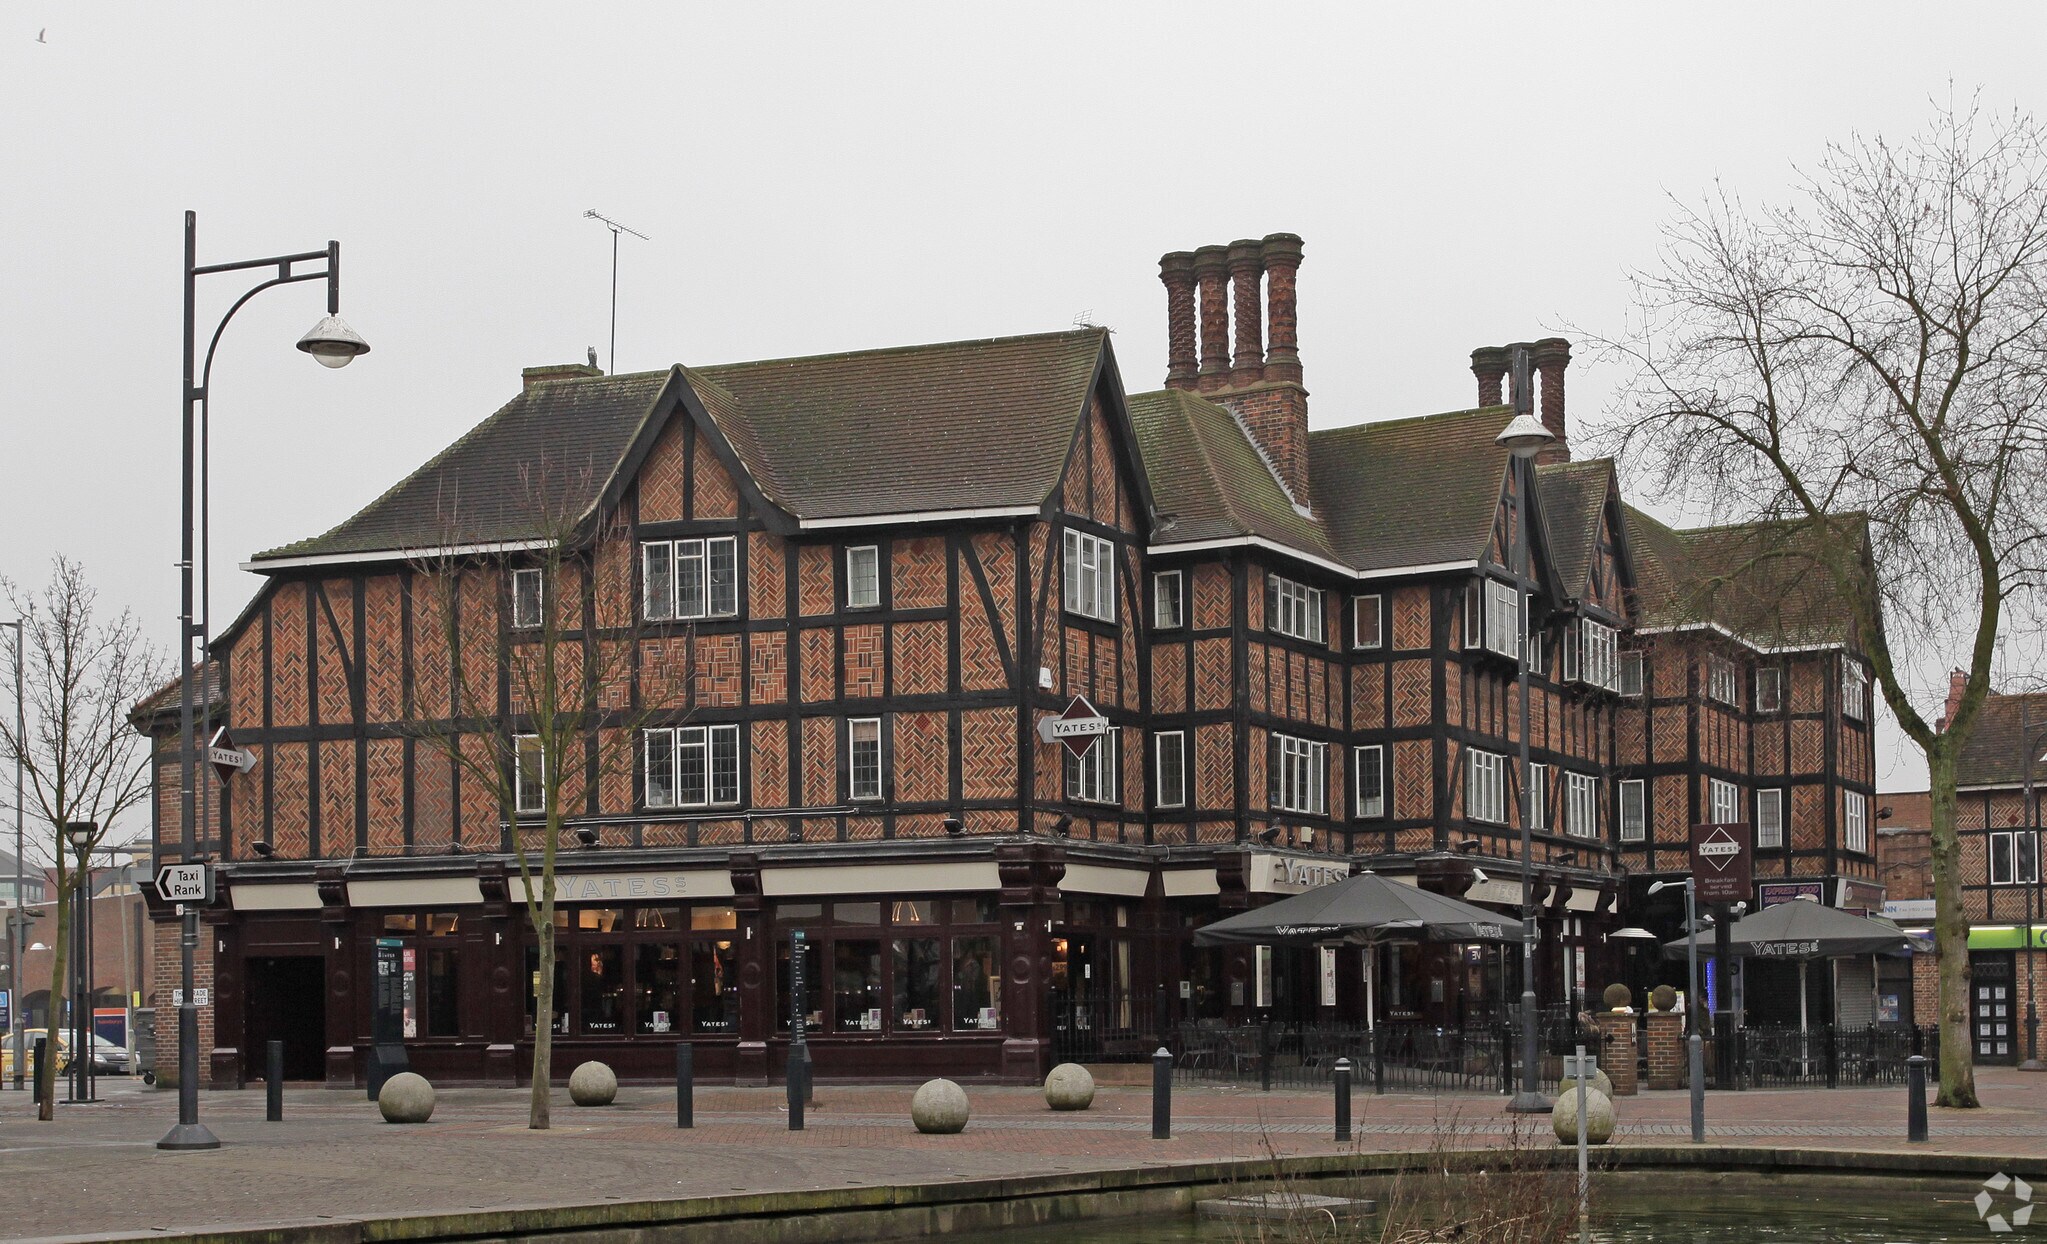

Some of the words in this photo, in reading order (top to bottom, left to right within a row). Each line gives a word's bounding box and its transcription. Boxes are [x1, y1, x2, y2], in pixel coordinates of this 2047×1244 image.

[178, 870, 199, 881] Taxi
[174, 885, 201, 895] Rank
[1765, 887, 1797, 896] EXPRESS
[1798, 885, 1819, 894] FOOD
